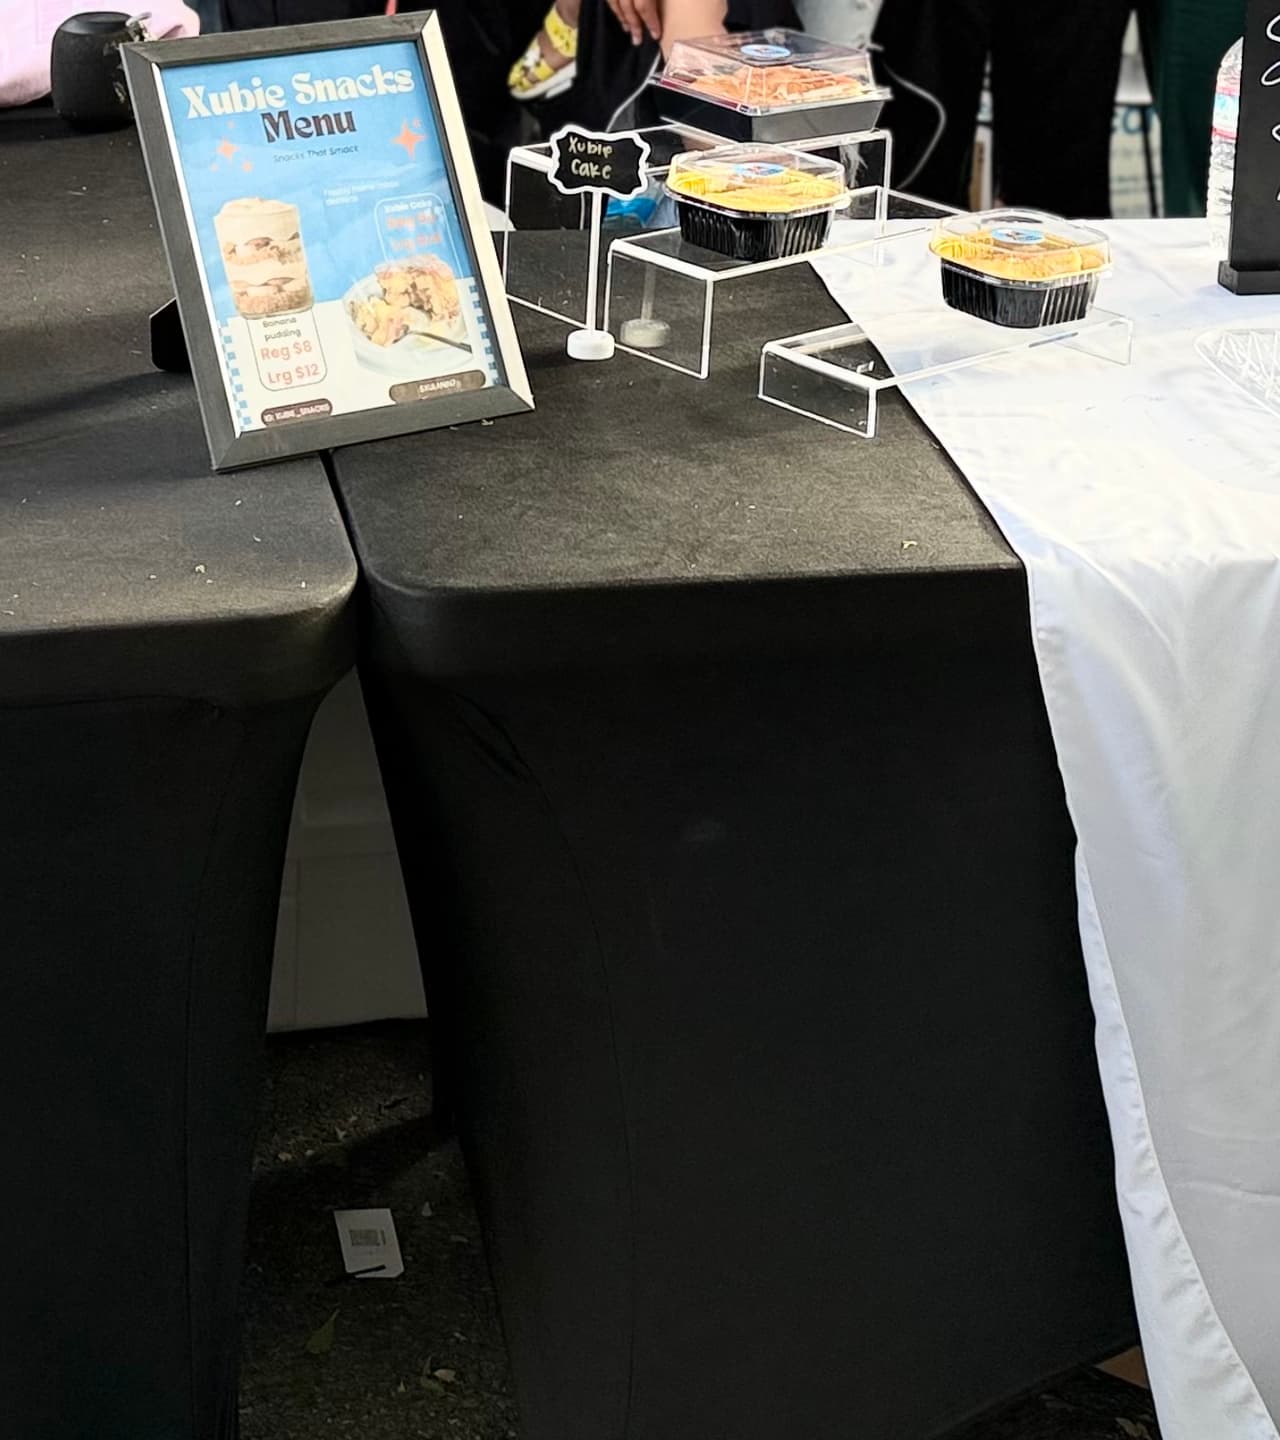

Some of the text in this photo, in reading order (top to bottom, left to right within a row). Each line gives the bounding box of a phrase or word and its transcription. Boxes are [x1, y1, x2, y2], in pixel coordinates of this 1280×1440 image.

[180, 64, 416, 120] Xubie Snacks
[261, 108, 358, 144] Menu
[570, 158, 612, 180] Cake
[262, 316, 297, 329] Banana
[264, 328, 302, 342] pudding
[260, 340, 313, 361] Reg $8
[267, 363, 321, 386] Lrg $12
